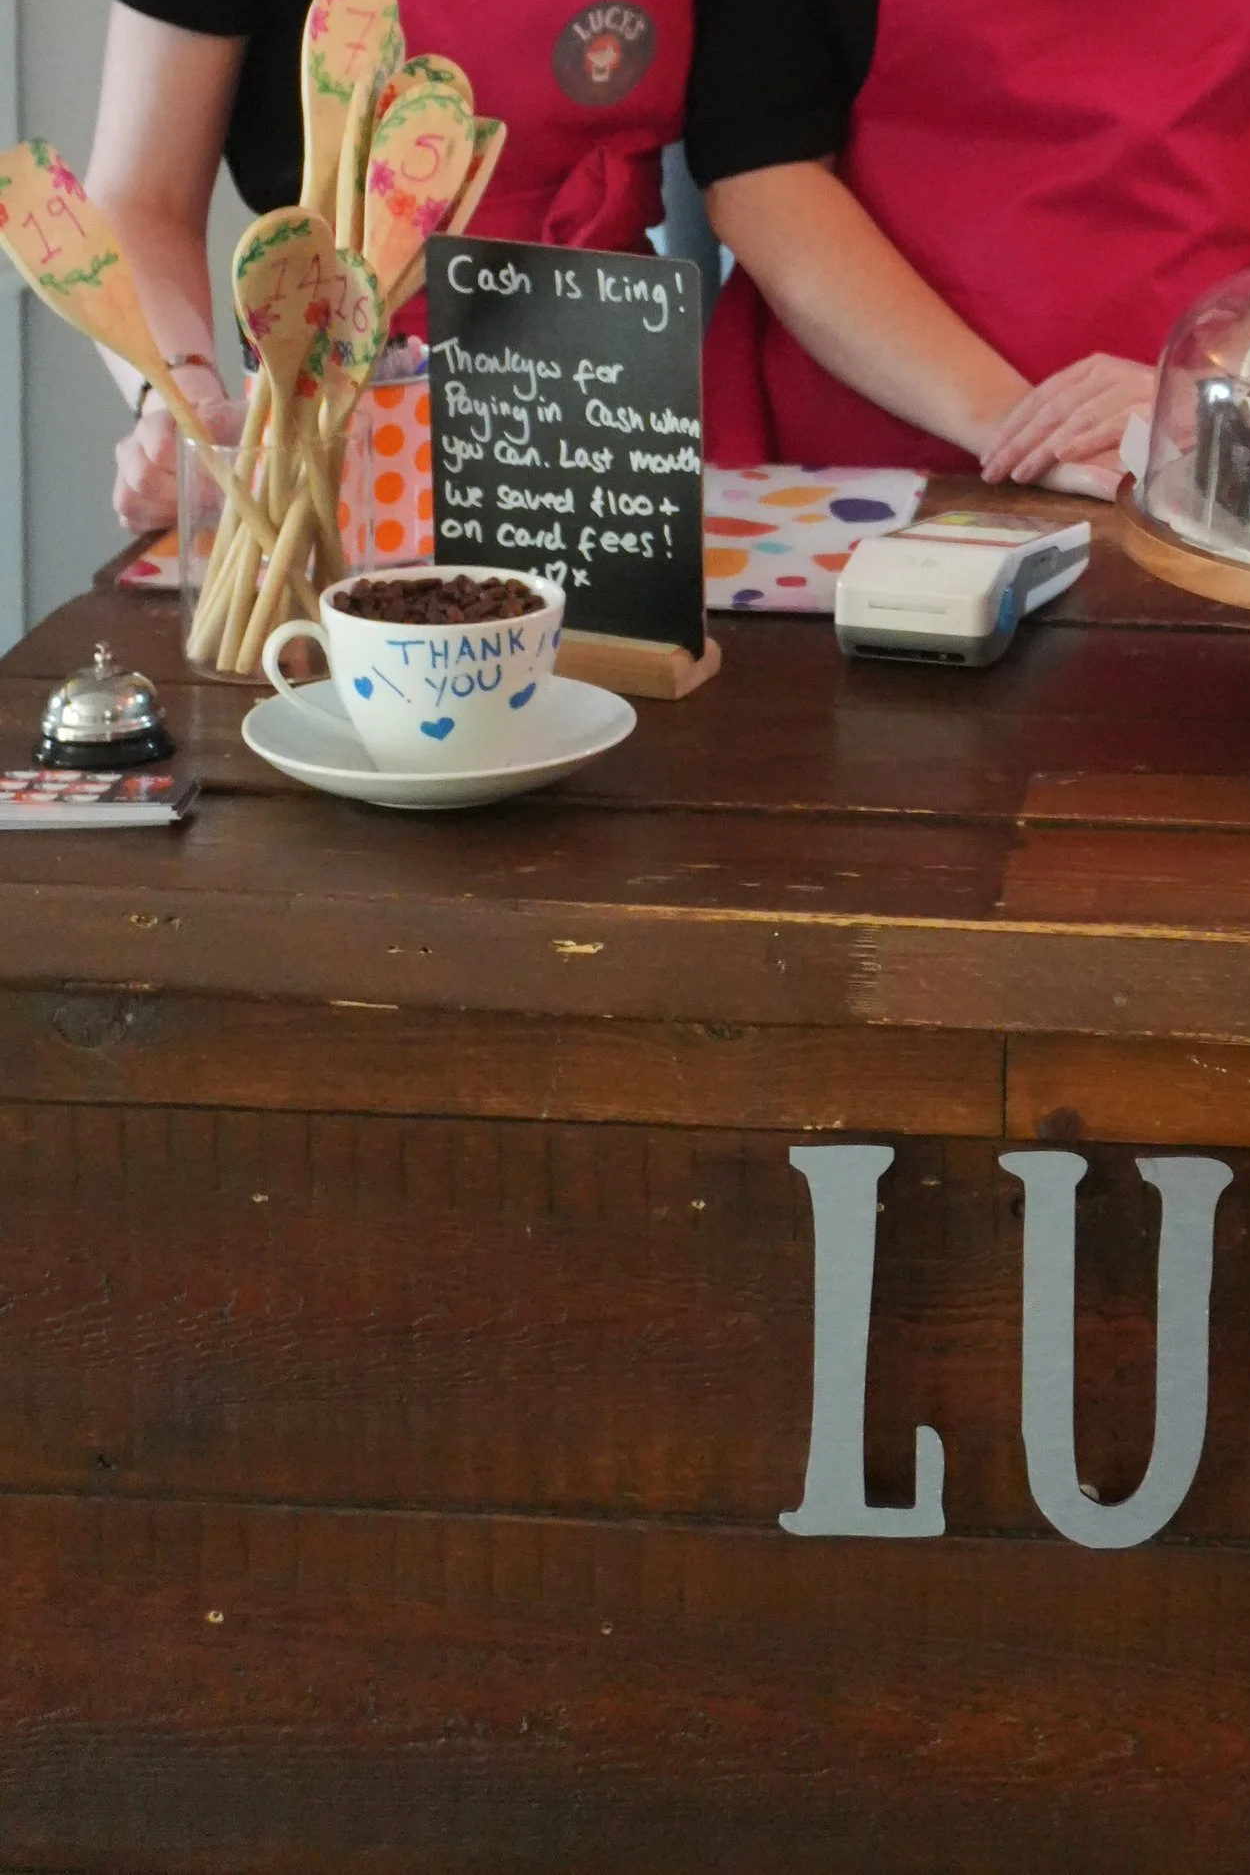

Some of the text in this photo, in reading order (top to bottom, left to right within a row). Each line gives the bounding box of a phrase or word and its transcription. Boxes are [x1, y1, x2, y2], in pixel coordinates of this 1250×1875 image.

[400, 132, 445, 183] 5
[21, 194, 86, 265] 19
[447, 254, 531, 295] Cash
[572, 358, 625, 395] for
[537, 396, 563, 423] in
[649, 408, 701, 439] when
[442, 433, 484, 474] you
[559, 438, 614, 474] Last
[386, 628, 525, 670] THANK
[424, 664, 503, 707] YOU
